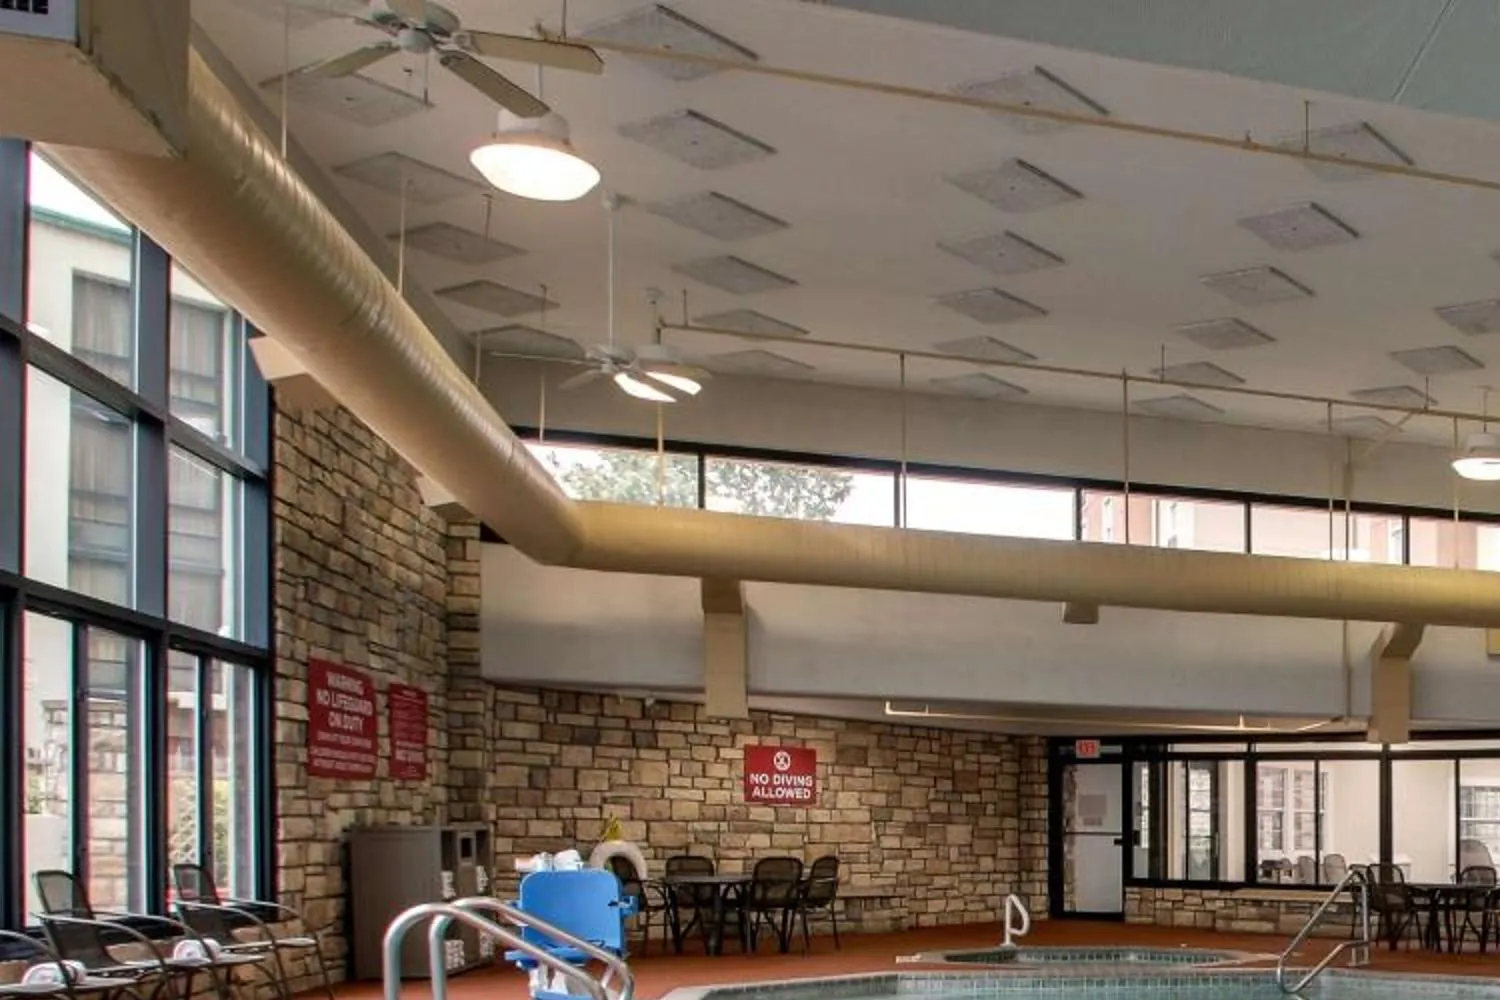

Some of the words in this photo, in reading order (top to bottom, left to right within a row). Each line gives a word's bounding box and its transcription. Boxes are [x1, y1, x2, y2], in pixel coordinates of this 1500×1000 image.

[749, 773, 769, 785] NO
[773, 774, 813, 787] DIVING
[752, 786, 811, 799] ALLOWED
